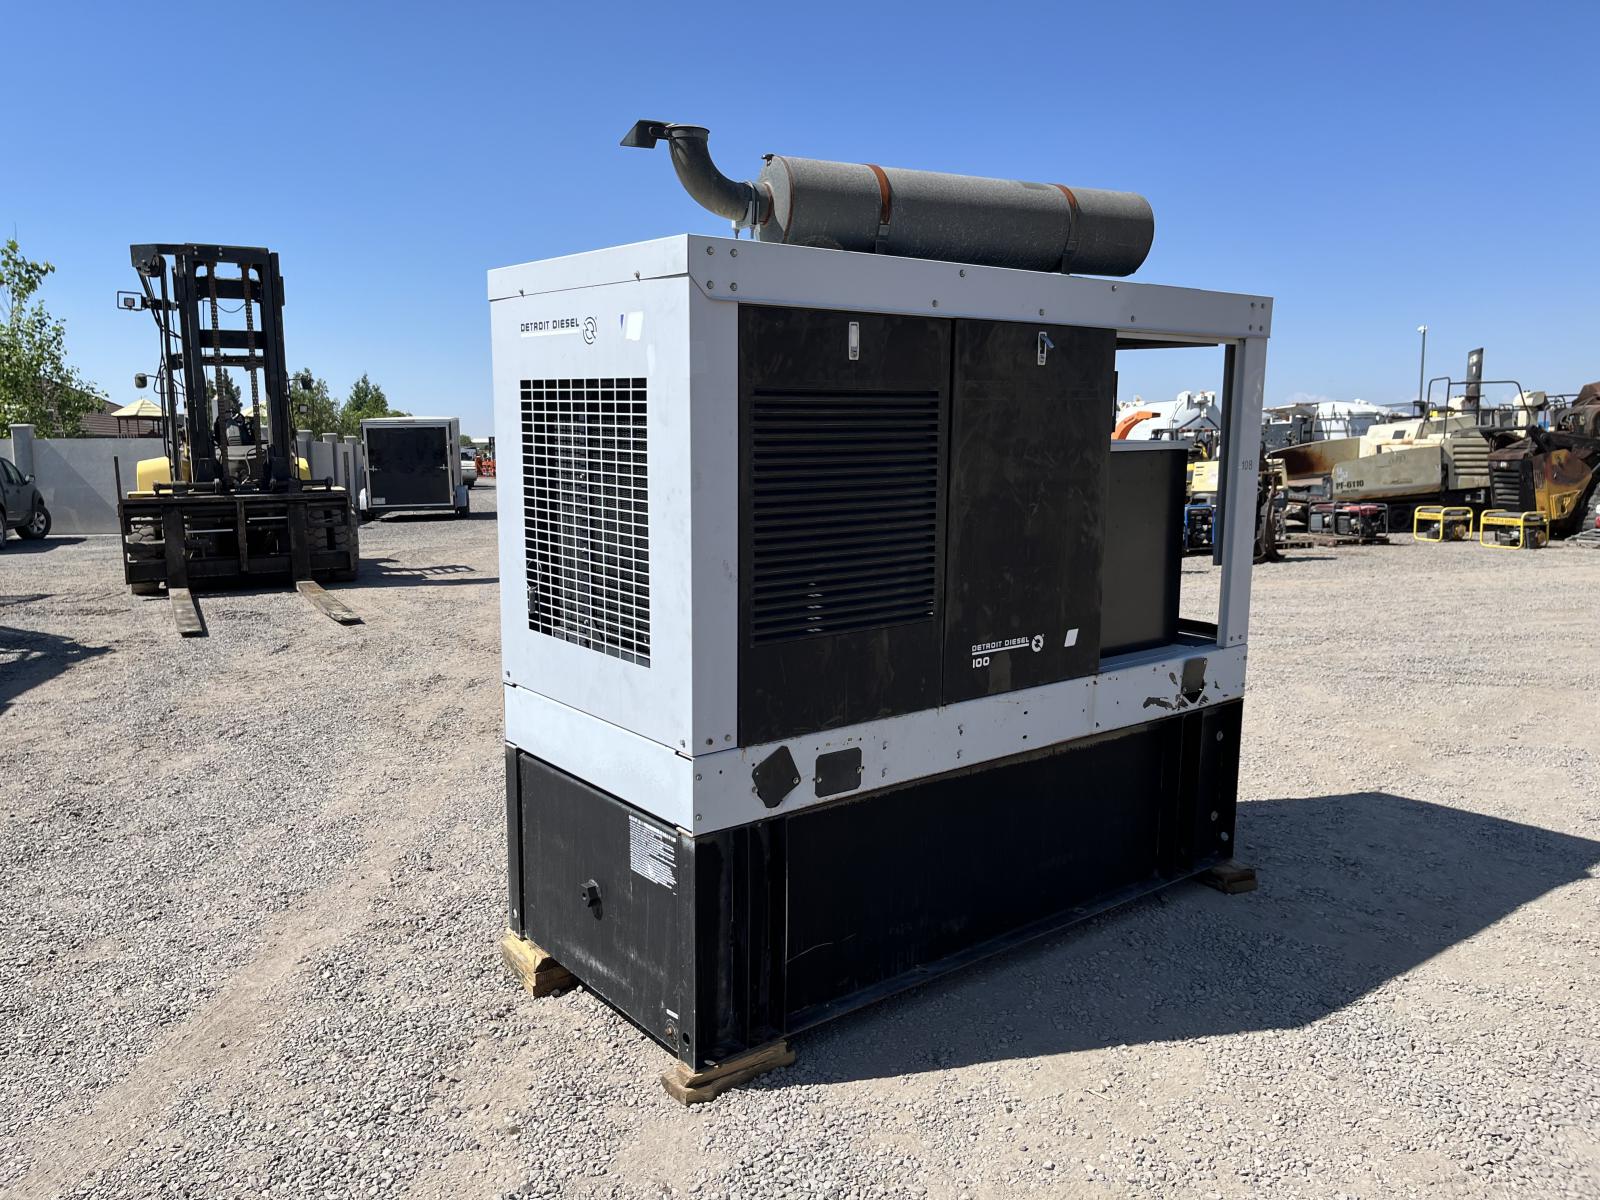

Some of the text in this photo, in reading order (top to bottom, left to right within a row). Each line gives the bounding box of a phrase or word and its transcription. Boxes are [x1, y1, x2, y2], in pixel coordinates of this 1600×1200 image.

[520, 317, 580, 332] DETROIT DIESEL
[971, 636, 1030, 652] DETROIT DIESEL
[972, 656, 990, 669] 100
